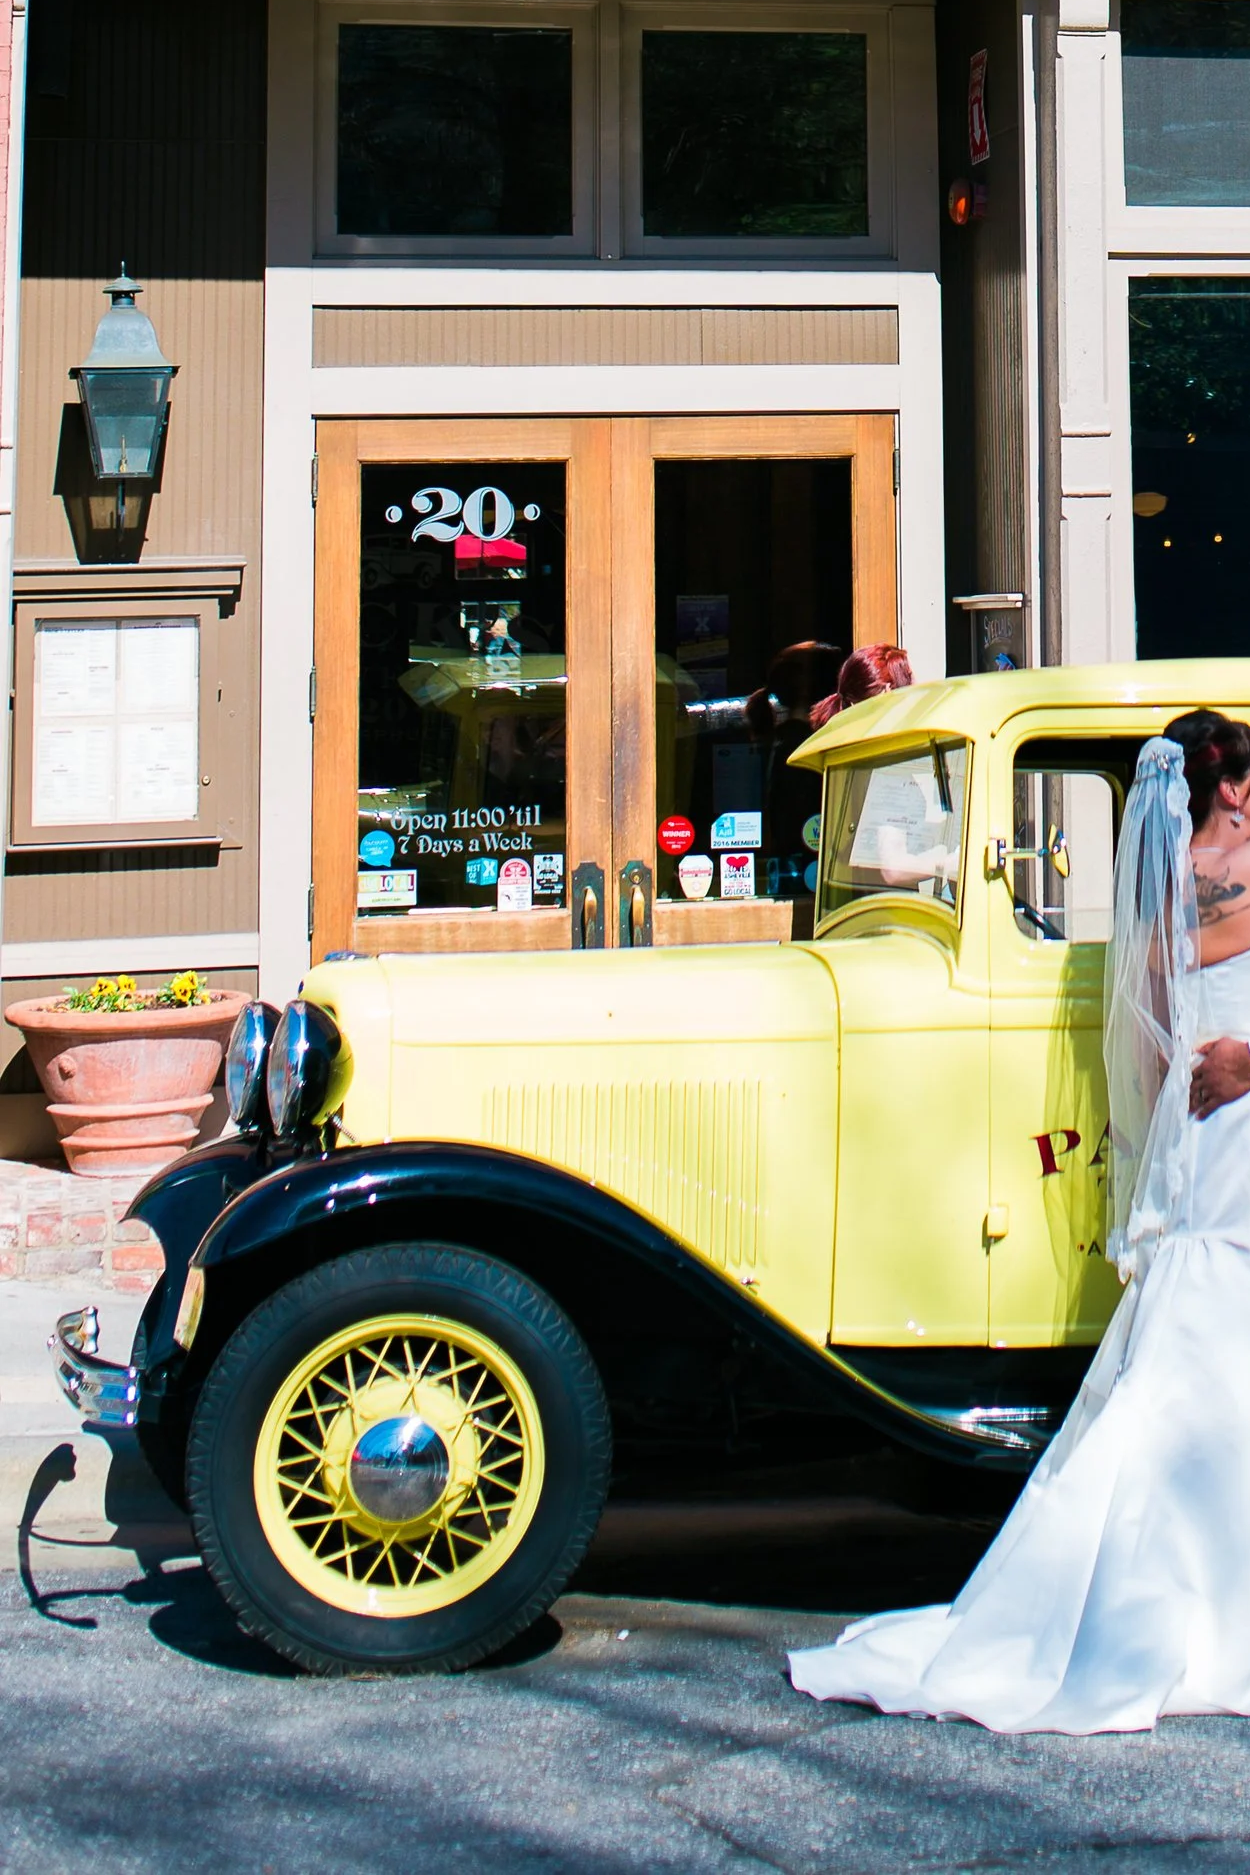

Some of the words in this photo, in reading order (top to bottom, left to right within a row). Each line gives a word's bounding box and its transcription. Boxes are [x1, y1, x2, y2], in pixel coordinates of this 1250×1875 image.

[391, 808, 447, 835] Open
[452, 807, 505, 829] 11:00
[398, 836, 412, 854] 7
[416, 835, 464, 857] Days
[468, 840, 480, 852] a
[482, 832, 533, 851] Week
[662, 830, 691, 838] WINNER
